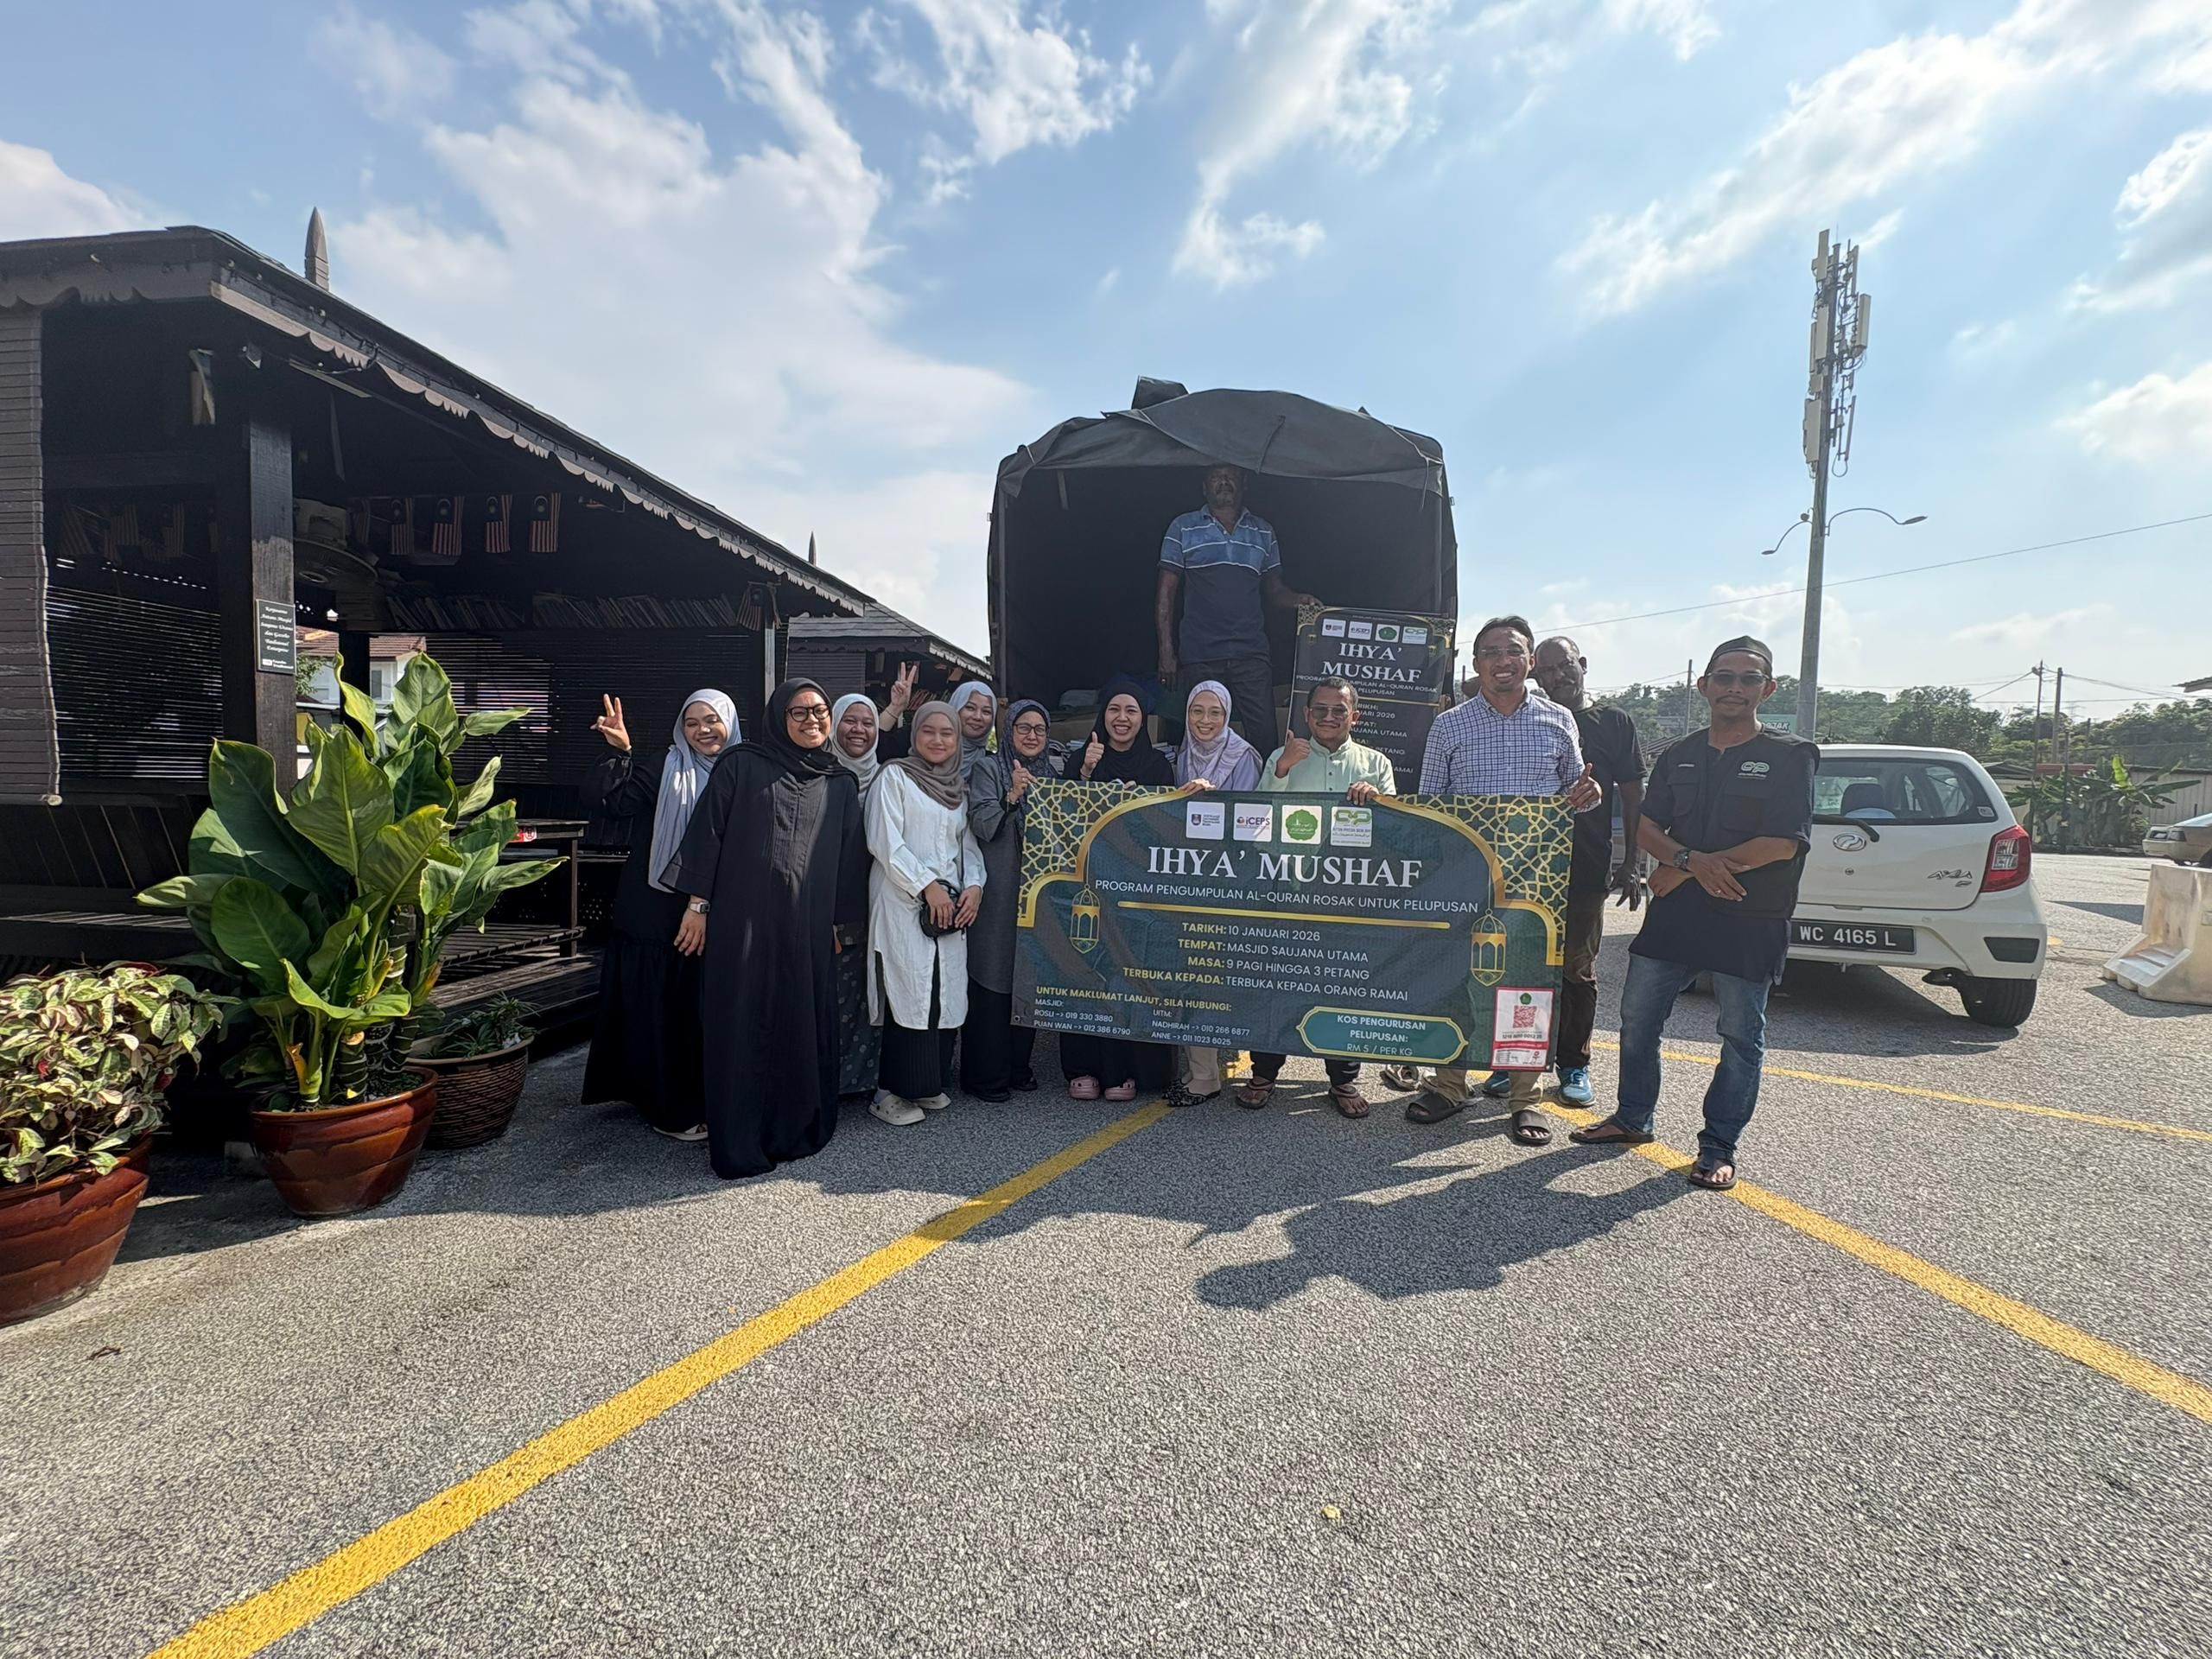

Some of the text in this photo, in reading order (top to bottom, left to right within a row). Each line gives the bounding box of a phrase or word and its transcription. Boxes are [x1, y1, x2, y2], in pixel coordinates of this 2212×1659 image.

[1338, 642, 1402, 661] IHYA'
[1321, 661, 1421, 683] MUSHAF
[1147, 847, 1422, 887] IHYA' MUSHAF
[1096, 880, 1478, 913] PROGRAM PENGUMPULAN AL-QURAN ROSAK UNTUK PELUPUSAN
[1182, 922, 1320, 941] TARIKH: 10 JANUARI 2026
[1800, 925, 1897, 947] WC 4165 L
[1178, 938, 1369, 962] TEMPAT: MASJID SAUJANA UTAMA
[1187, 956, 1370, 980] MASA: 9 PAGI HINGGA 3 PETANG
[1123, 967, 1408, 1001] TERBUKA KEPADA: TERBUKA KEPADA ORANG RAMAI
[1037, 986, 1232, 1012] UNTUK MAKLUMAT LANJUT, SILA HUBUNGI:
[1054, 1021, 1072, 1030] WAN
[1337, 1014, 1426, 1031] KOS PENGURUSAN
[1151, 1031, 1172, 1040] ANNE
[1350, 1030, 1408, 1043] PELUPUSAN:
[1346, 1043, 1362, 1052] RM
[1363, 1044, 1370, 1053] 5
[1380, 1046, 1397, 1056] PER
[1399, 1047, 1413, 1056] KG
